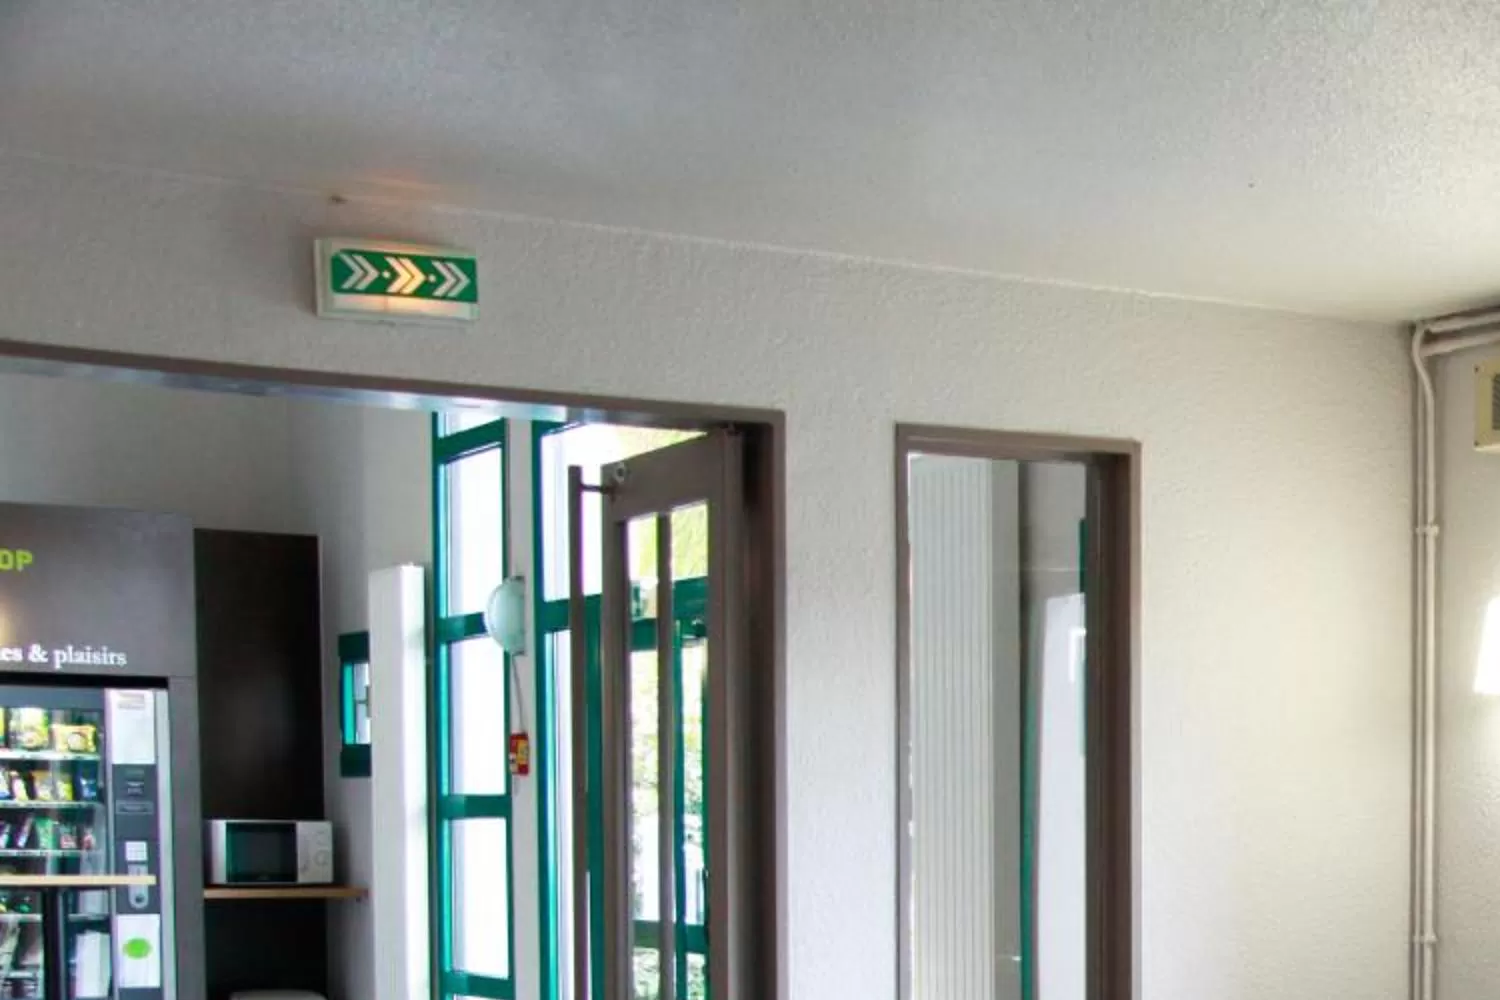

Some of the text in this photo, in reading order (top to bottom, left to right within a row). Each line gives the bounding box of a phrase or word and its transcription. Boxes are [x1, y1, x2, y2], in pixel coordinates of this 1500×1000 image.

[0, 550, 33, 571] OP
[28, 643, 48, 662] &
[53, 644, 127, 668] plaisirs
